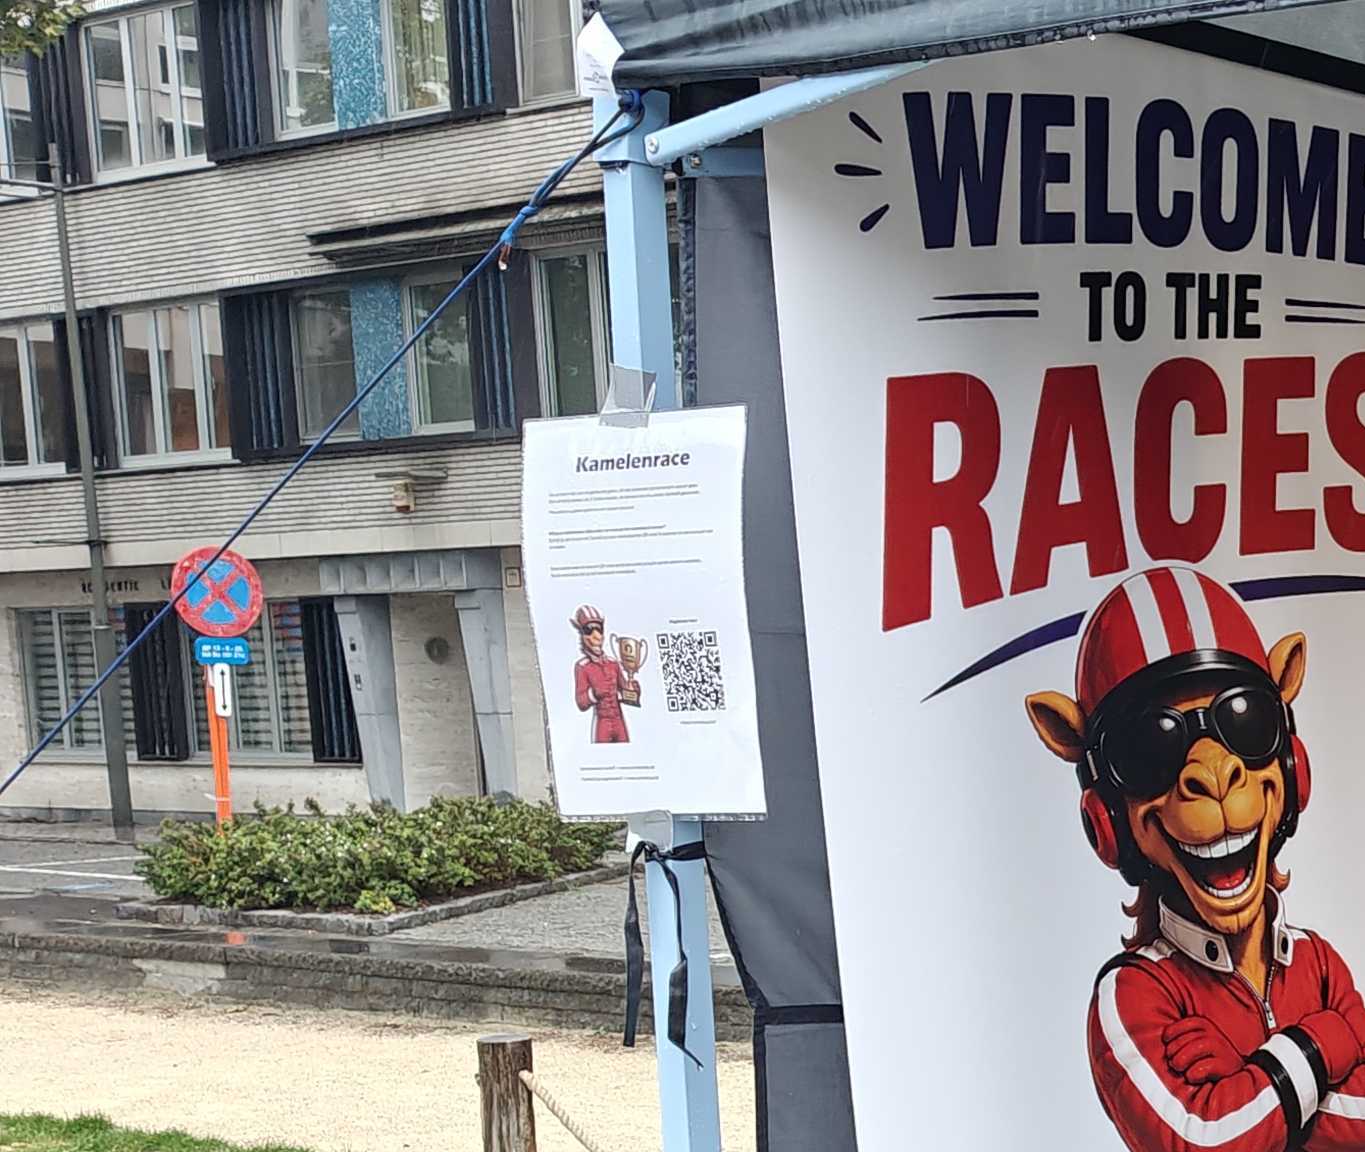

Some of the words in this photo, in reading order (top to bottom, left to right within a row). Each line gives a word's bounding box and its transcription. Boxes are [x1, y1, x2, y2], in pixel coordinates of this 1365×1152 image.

[1080, 271, 1147, 341] TO
[1166, 272, 1262, 340] THE
[575, 451, 690, 473] Kamelenrace
